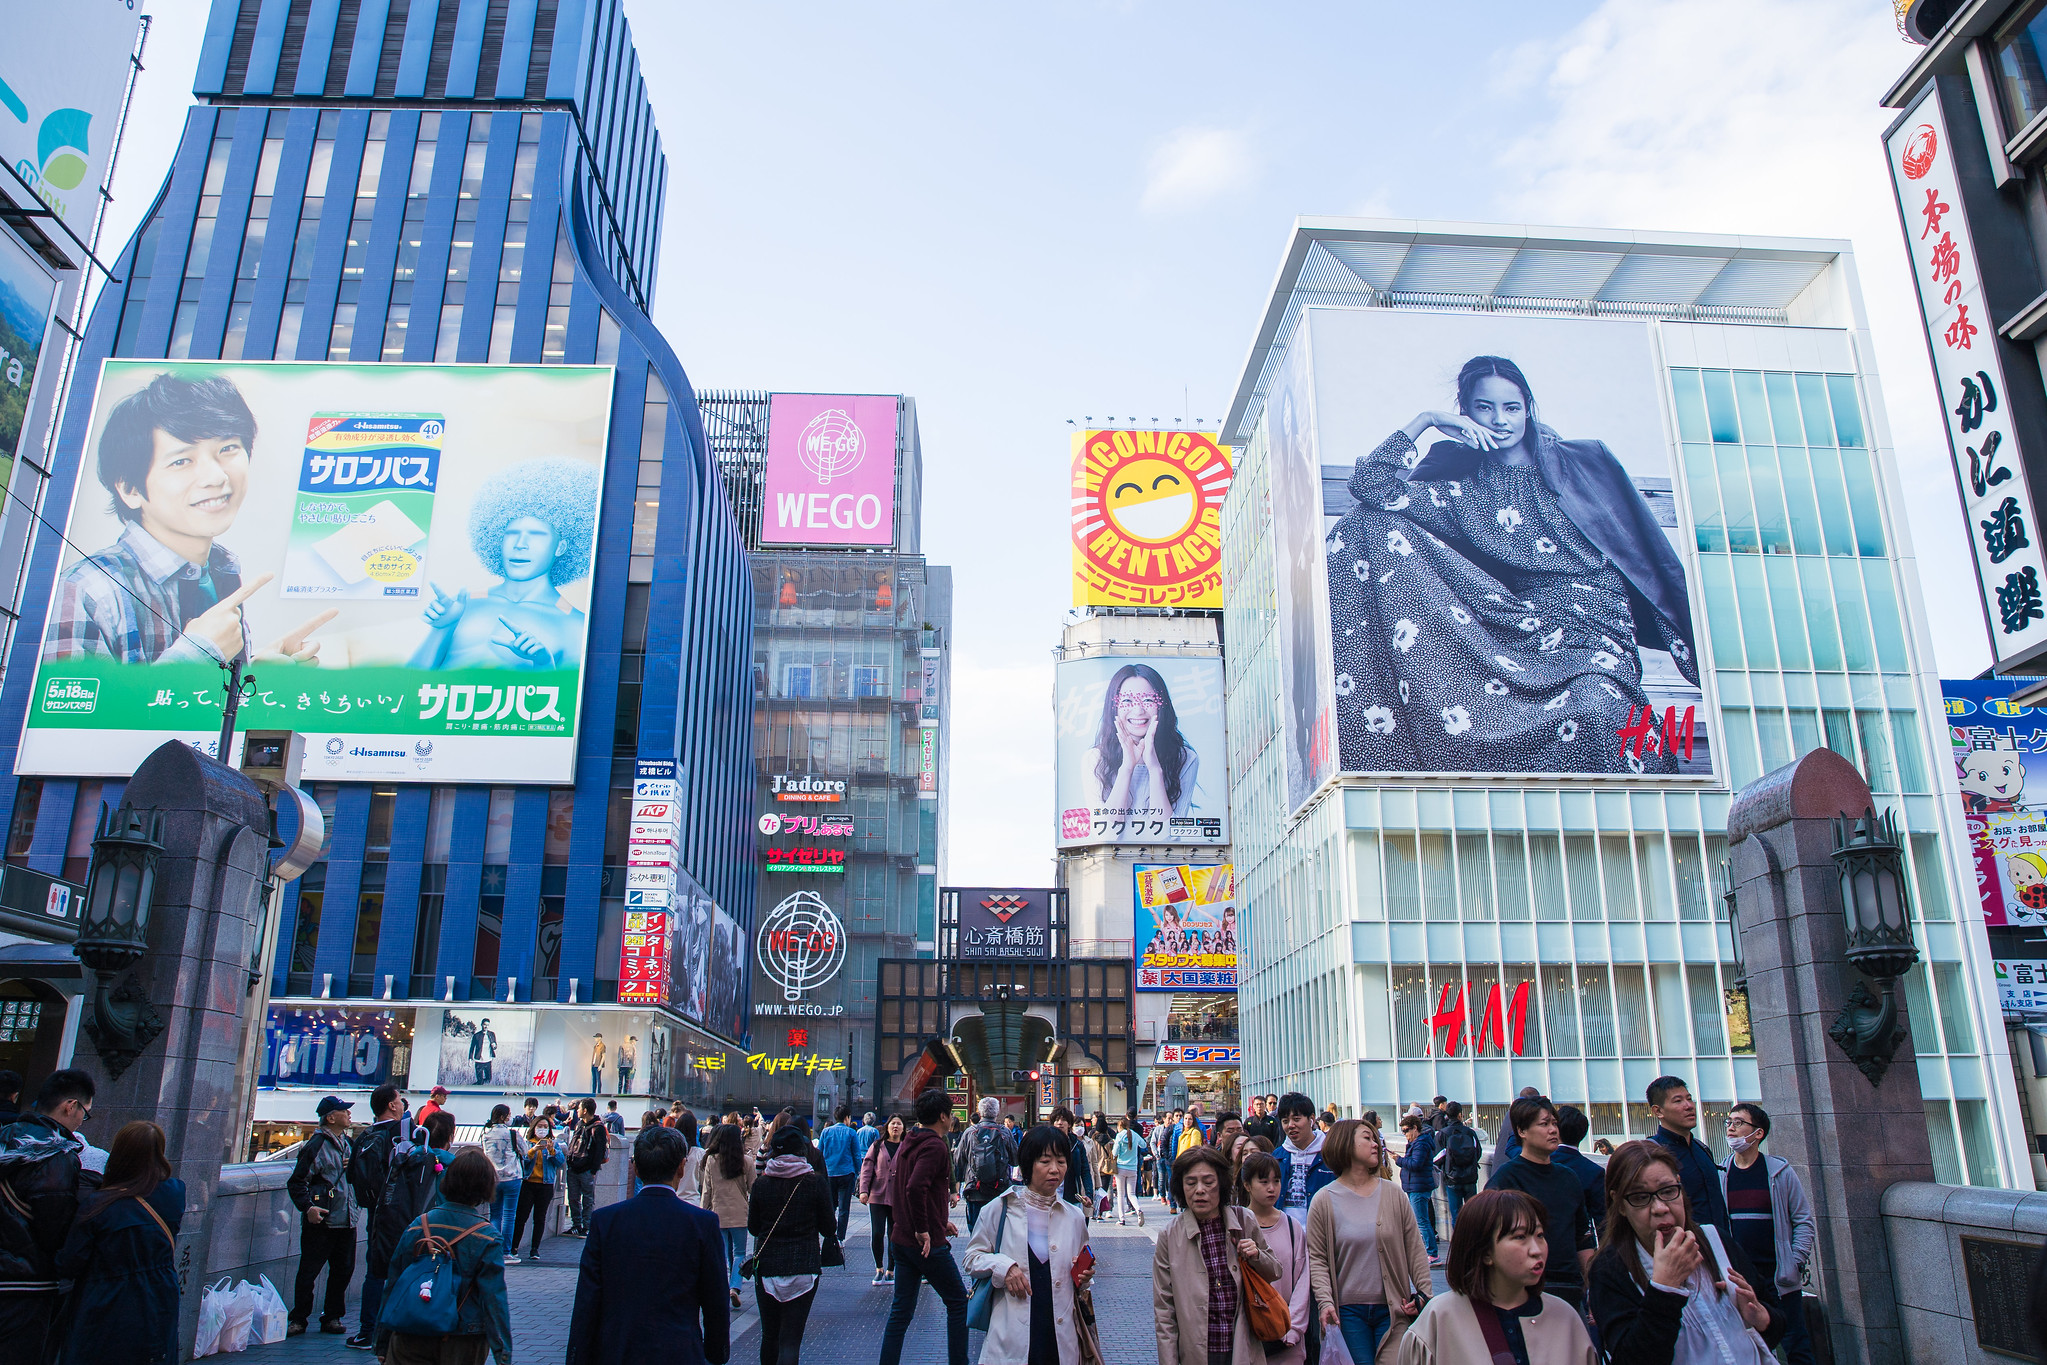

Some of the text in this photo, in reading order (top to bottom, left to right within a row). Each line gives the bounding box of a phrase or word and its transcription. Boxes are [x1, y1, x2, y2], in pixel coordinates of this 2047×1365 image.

[14, 158, 67, 222] mint!
[1920, 187, 1978, 351] 本場の味
[353, 421, 400, 430] Hisamitsu
[423, 424, 440, 436] 40
[1072, 430, 1212, 492] NICONICO
[309, 455, 430, 486] サロンパス
[776, 492, 882, 530] WEGO
[380, 554, 404, 562] ちょっと
[369, 563, 412, 571] 大きめサイズ
[48, 685, 95, 699] 5月18日は
[46, 701, 93, 711] サロンパスの日
[418, 683, 562, 722] サロンパス
[1615, 703, 1695, 761] H&M
[924, 731, 934, 770] サイゼリヤ
[1309, 706, 1329, 778] H&M
[349, 747, 406, 757] Hisamitsu
[771, 775, 846, 793] J'adore
[639, 805, 667, 816] TKP
[1093, 808, 1164, 816] 運命の出会いアプリ
[763, 818, 777, 831] 7F
[1093, 820, 1164, 836] ワクワク
[767, 847, 845, 864] サイゼリヤ
[625, 935, 645, 946] 24H
[964, 925, 1044, 946] 心斎橋筋
[643, 912, 663, 993] インターネット
[964, 947, 982, 957] SHIN
[1143, 953, 1238, 967] スタッフ大募集中
[624, 947, 641, 993] コミック
[1142, 970, 1159, 985] 薬
[1164, 971, 1238, 986] 大国薬粧
[755, 1003, 844, 1016] WWW.WEGO.JP
[1422, 980, 1530, 1057] H&M
[787, 1028, 808, 1047] 薬
[1164, 1045, 1179, 1062] 薬
[746, 1052, 846, 1075] マツモトキヨシ
[533, 1069, 560, 1087] H&M
